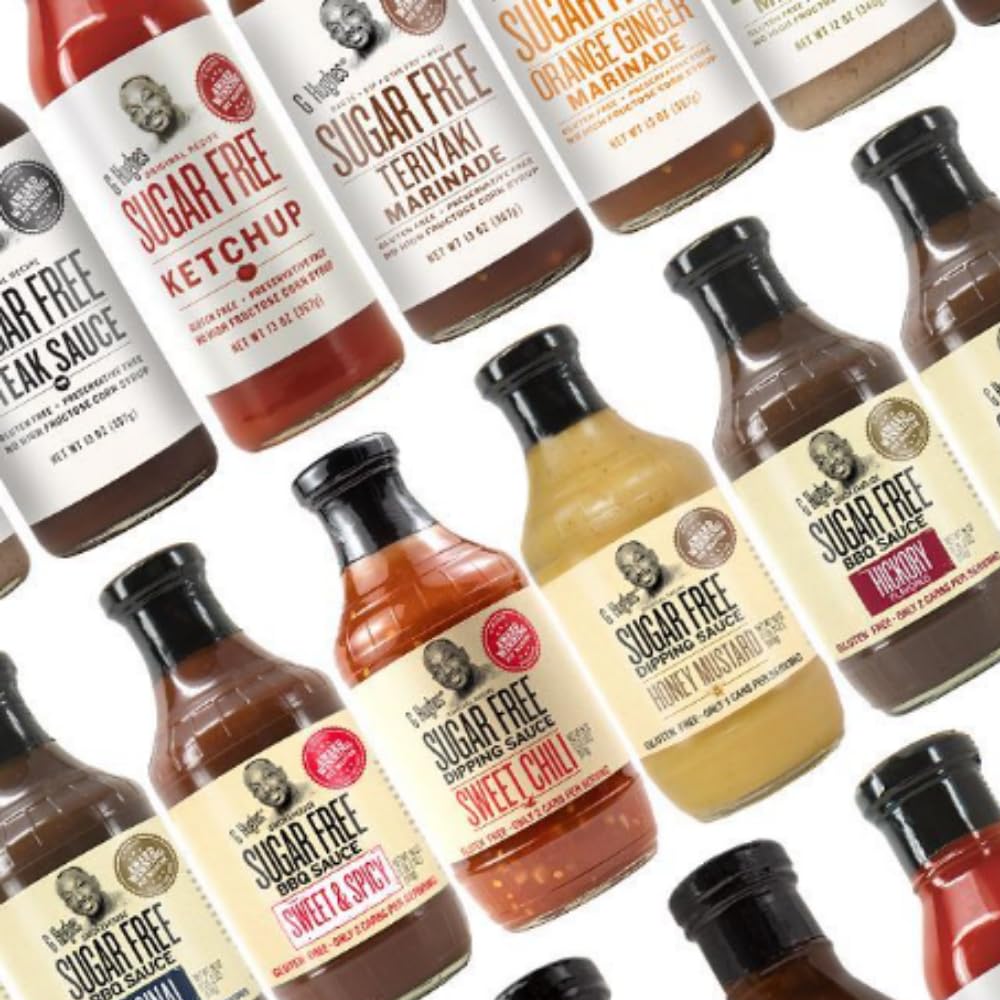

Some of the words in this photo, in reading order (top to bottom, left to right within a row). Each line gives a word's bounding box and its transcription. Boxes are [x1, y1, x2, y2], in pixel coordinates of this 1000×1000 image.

[530, 29, 620, 100] ORANGE
[570, 32, 686, 106] MARINADE
[315, 86, 422, 176] SUGAR
[407, 43, 491, 124] FREE
[122, 163, 221, 252] SUGAR
[204, 128, 281, 204] FREE
[377, 119, 481, 194] TERIYAKI
[385, 146, 504, 223] MARINADE
[25, 249, 104, 324] FREE
[162, 200, 300, 296] KETCHUP
[46, 306, 126, 371] SAUCE
[810, 495, 884, 562] SUGAR
[872, 467, 931, 526] FREE
[866, 541, 931, 595] HICKORY
[616, 601, 689, 664] SUGAR
[678, 573, 736, 629] FREE
[647, 665, 697, 710] HONEY
[692, 630, 761, 685] MUSTARD
[423, 705, 499, 770] SUGAR
[487, 676, 546, 734] FREE
[443, 744, 504, 785] DIPPING
[505, 714, 554, 750] SAUCE
[456, 762, 530, 825] SWEET
[519, 734, 577, 790] CHILI
[243, 822, 319, 888] SUGAR
[306, 794, 366, 852] FREE
[283, 888, 336, 937] SWEET
[330, 881, 352, 911] &
[344, 857, 390, 902] SPICY
[56, 932, 132, 999] SUGAR
[119, 903, 180, 963] FREE
[124, 950, 174, 987] SAUCE
